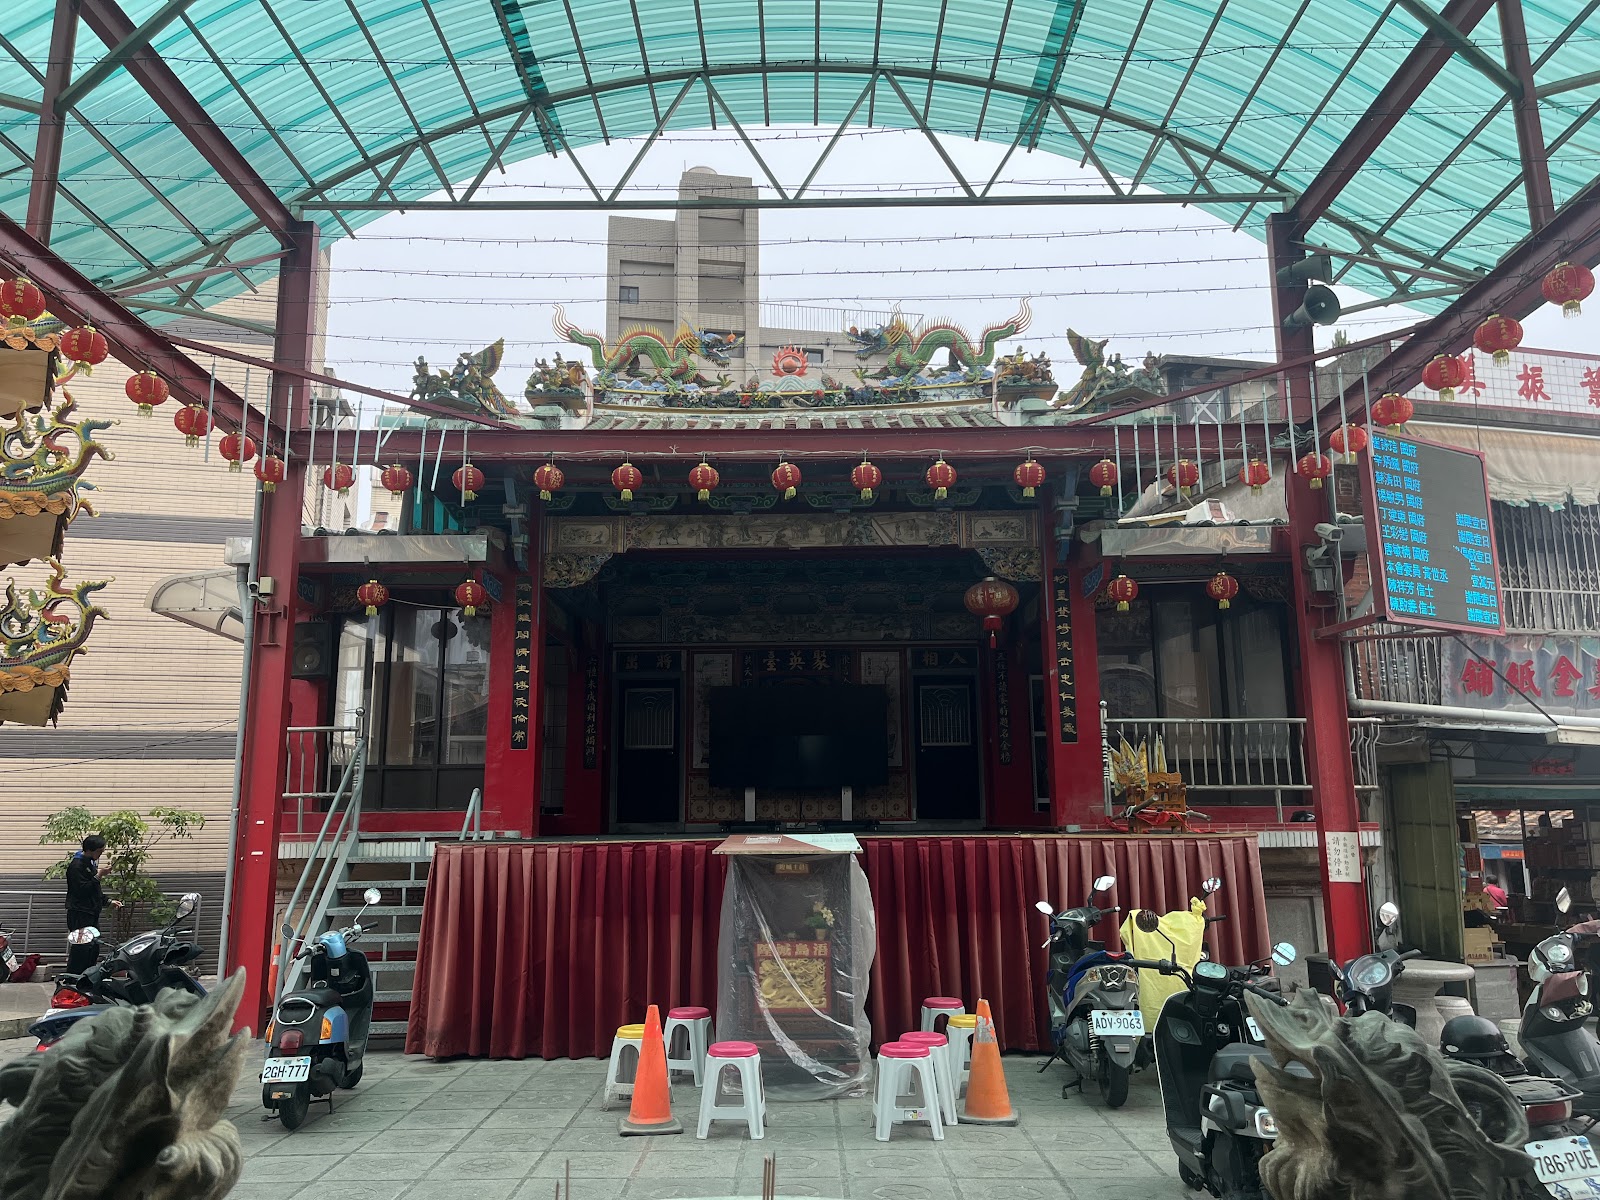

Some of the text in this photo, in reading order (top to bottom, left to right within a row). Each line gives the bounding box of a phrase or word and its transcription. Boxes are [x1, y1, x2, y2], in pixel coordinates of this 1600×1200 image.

[762, 650, 831, 672] 聚英臺
[1331, 836, 1343, 877] 請勿停車
[1095, 1016, 1143, 1030] ADV-9063
[263, 1064, 309, 1079] 2GH-777
[1536, 1149, 1598, 1176] 786-PUE
